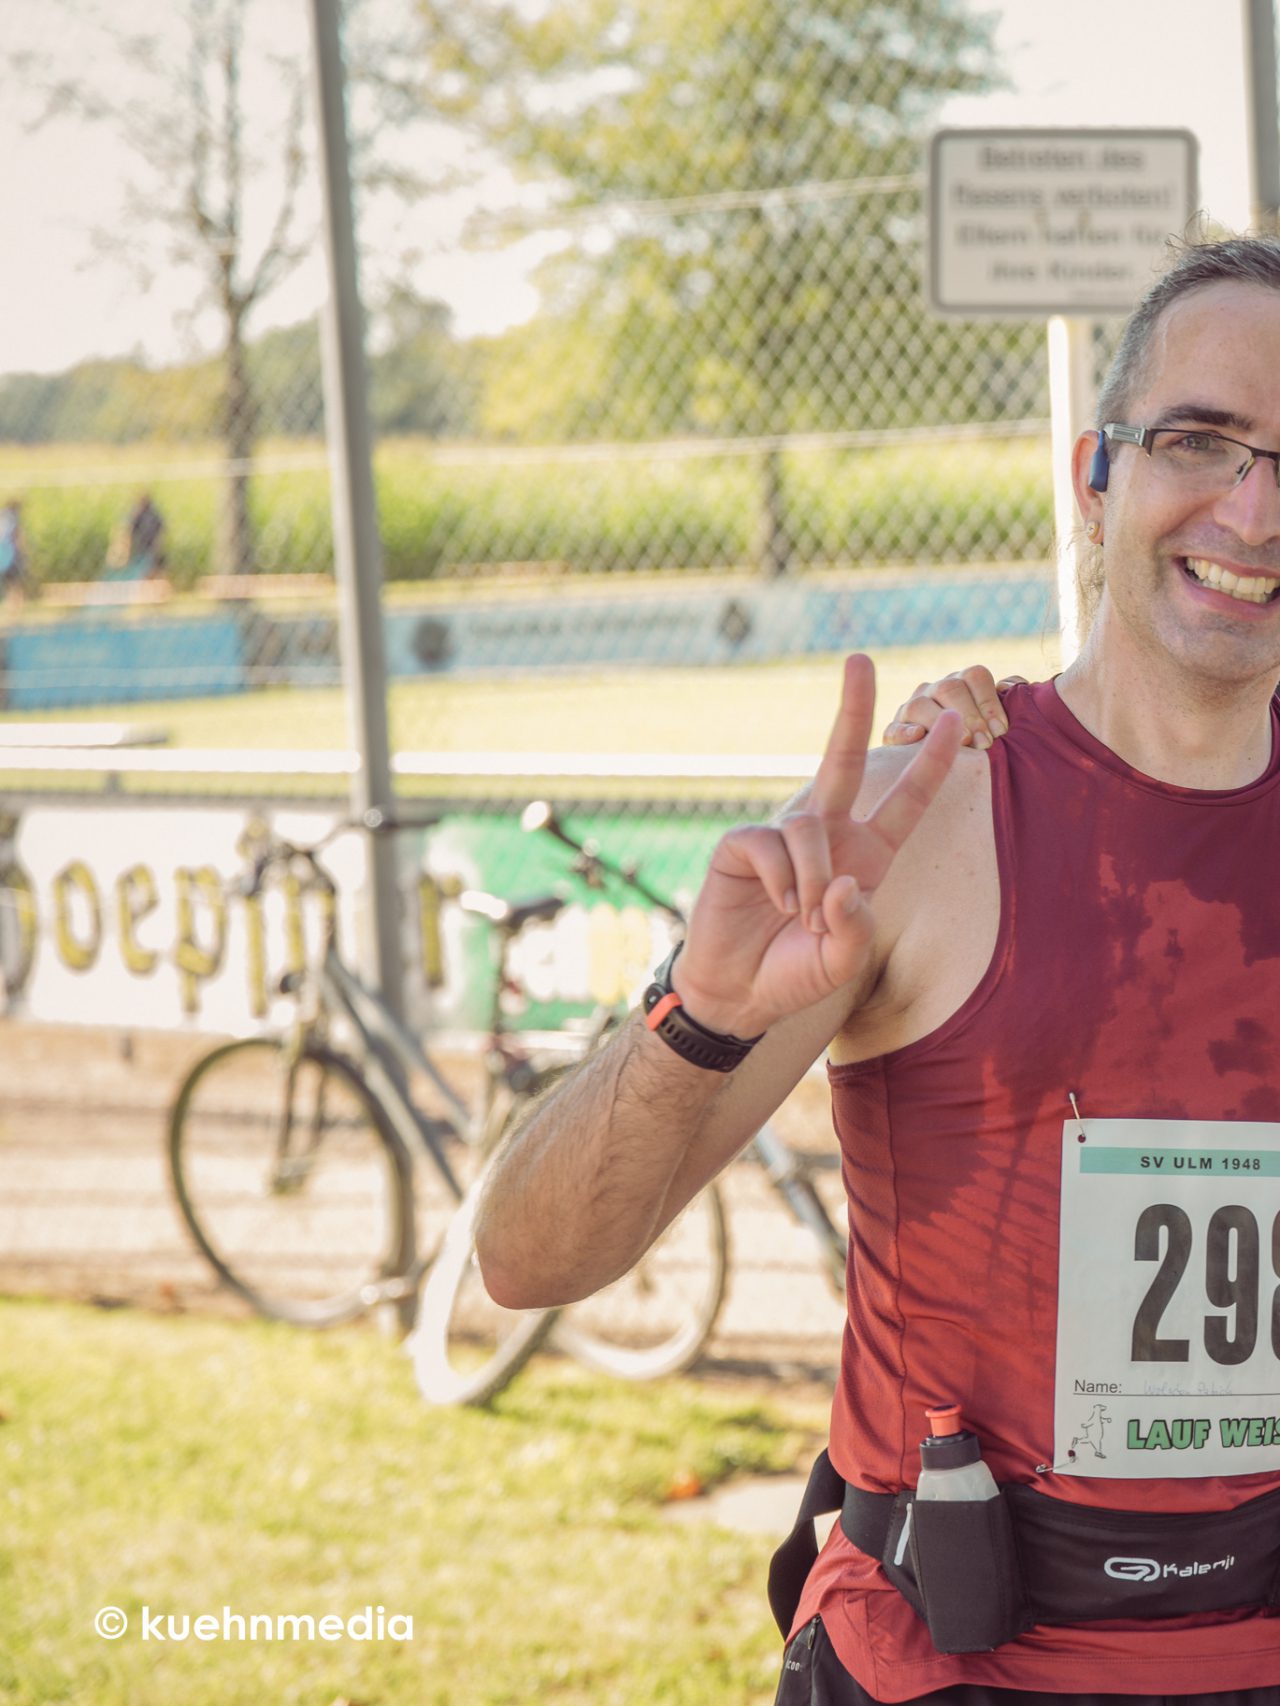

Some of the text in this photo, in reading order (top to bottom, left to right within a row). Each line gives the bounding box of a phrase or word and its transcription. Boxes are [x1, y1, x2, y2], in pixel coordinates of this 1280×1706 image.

[1140, 1155, 1261, 1171] SV ULM 1948
[1074, 1379, 1122, 1394] Name:
[1126, 1418, 1211, 1451] LAUF
[1163, 1555, 1235, 1578] Kalenji
